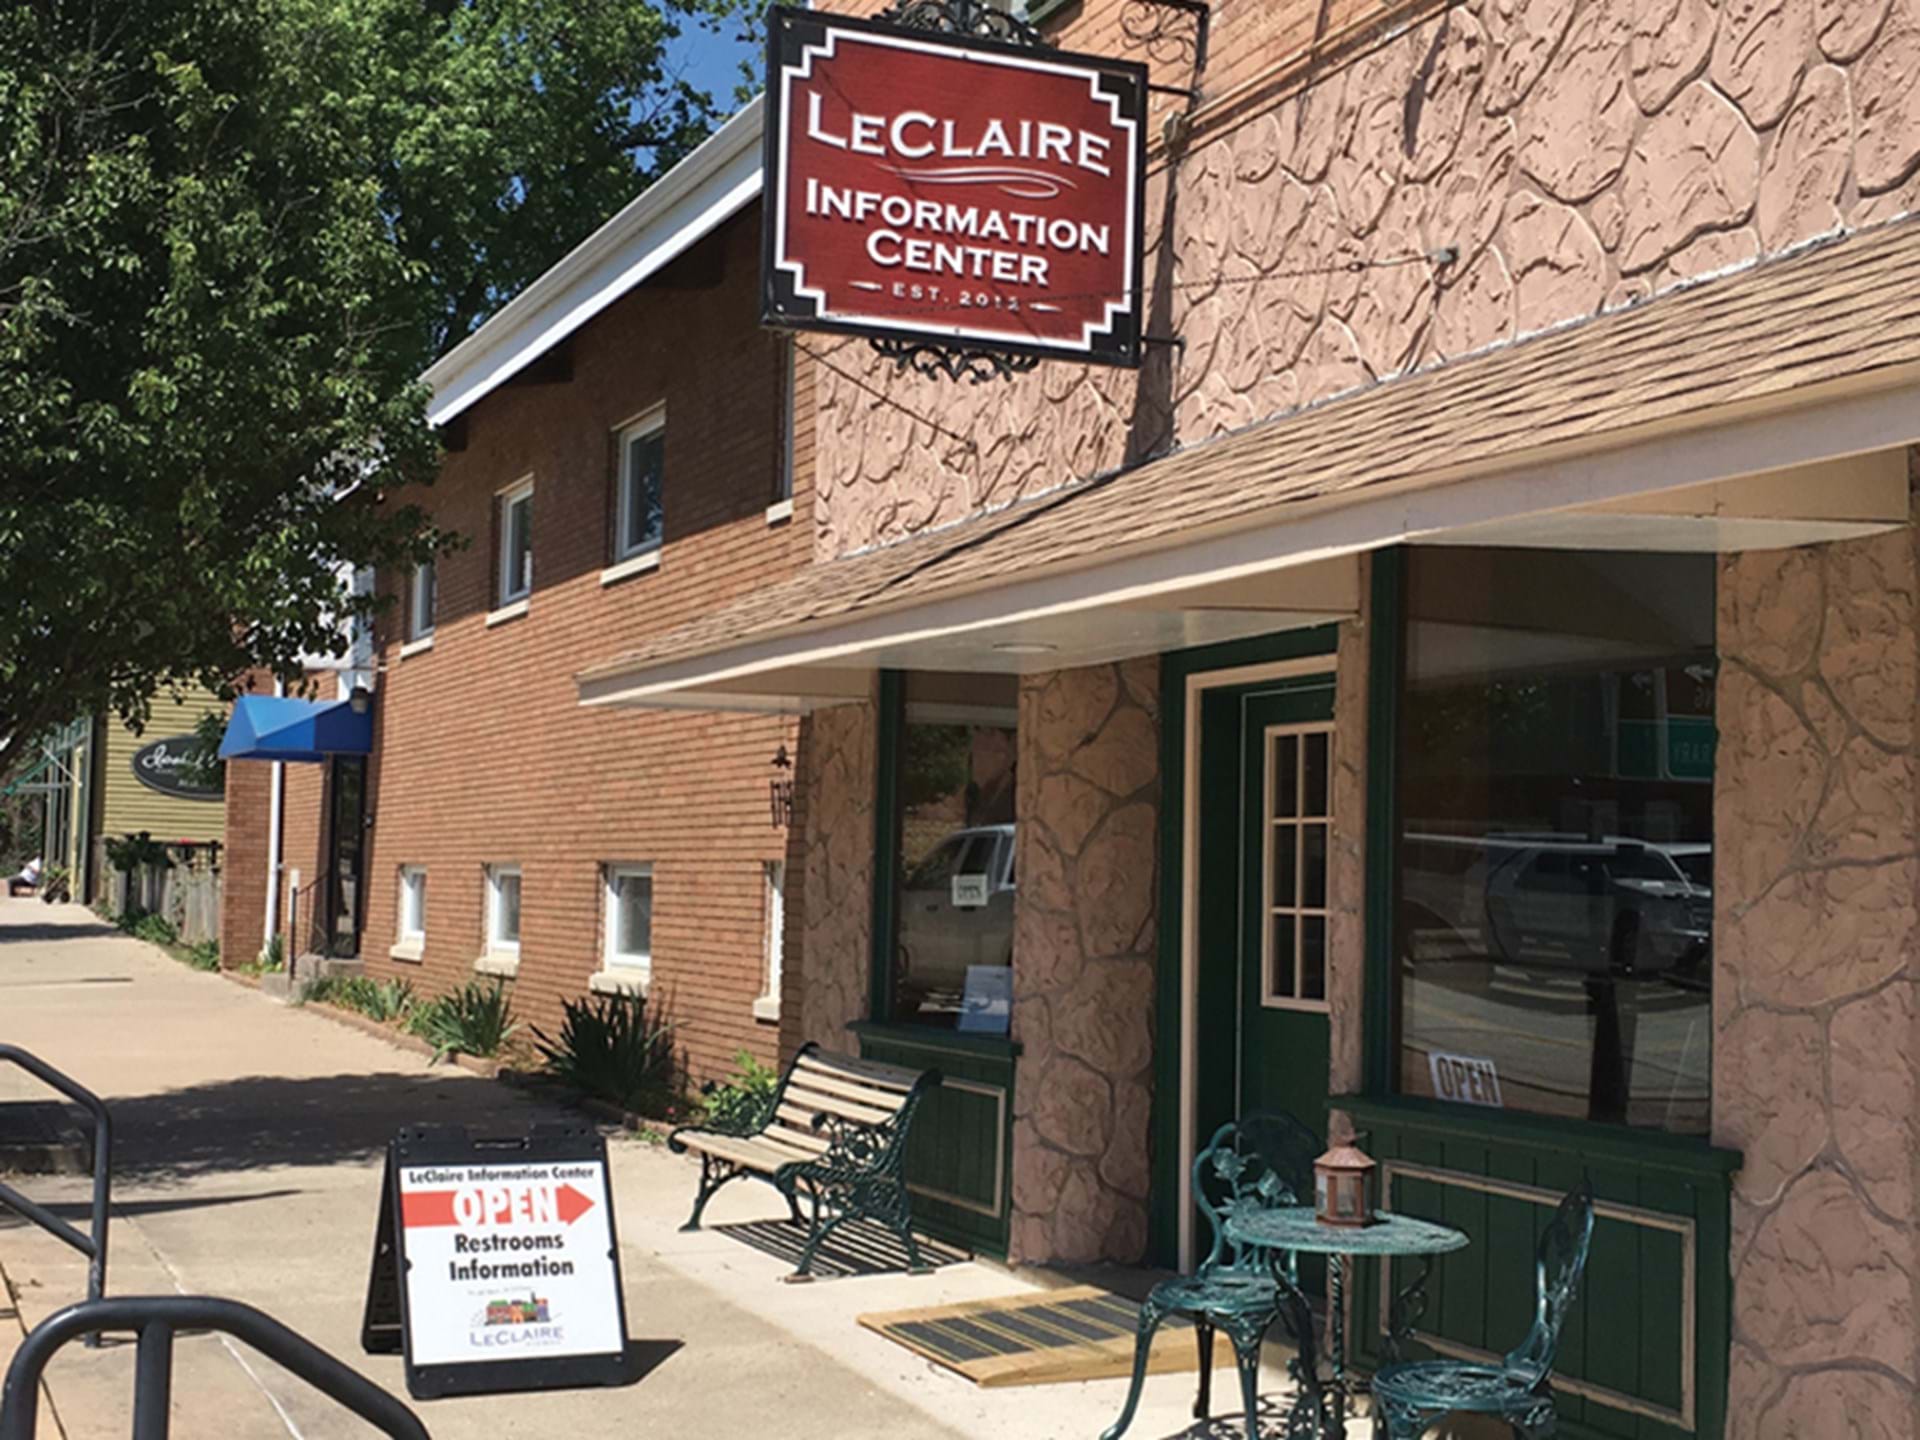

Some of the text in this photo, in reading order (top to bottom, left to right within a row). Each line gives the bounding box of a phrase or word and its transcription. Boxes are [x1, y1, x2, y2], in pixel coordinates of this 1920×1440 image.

[805, 178, 1110, 254] INFORMATION
[865, 230, 1049, 286] CENTER
[892, 281, 950, 304] EST.
[1437, 1056, 1498, 1104] OPEN
[409, 1167, 595, 1184] LeClaire Information Center
[453, 1186, 556, 1227] OPEN
[454, 1233, 565, 1254] Restrooms
[449, 1256, 575, 1282] Information
